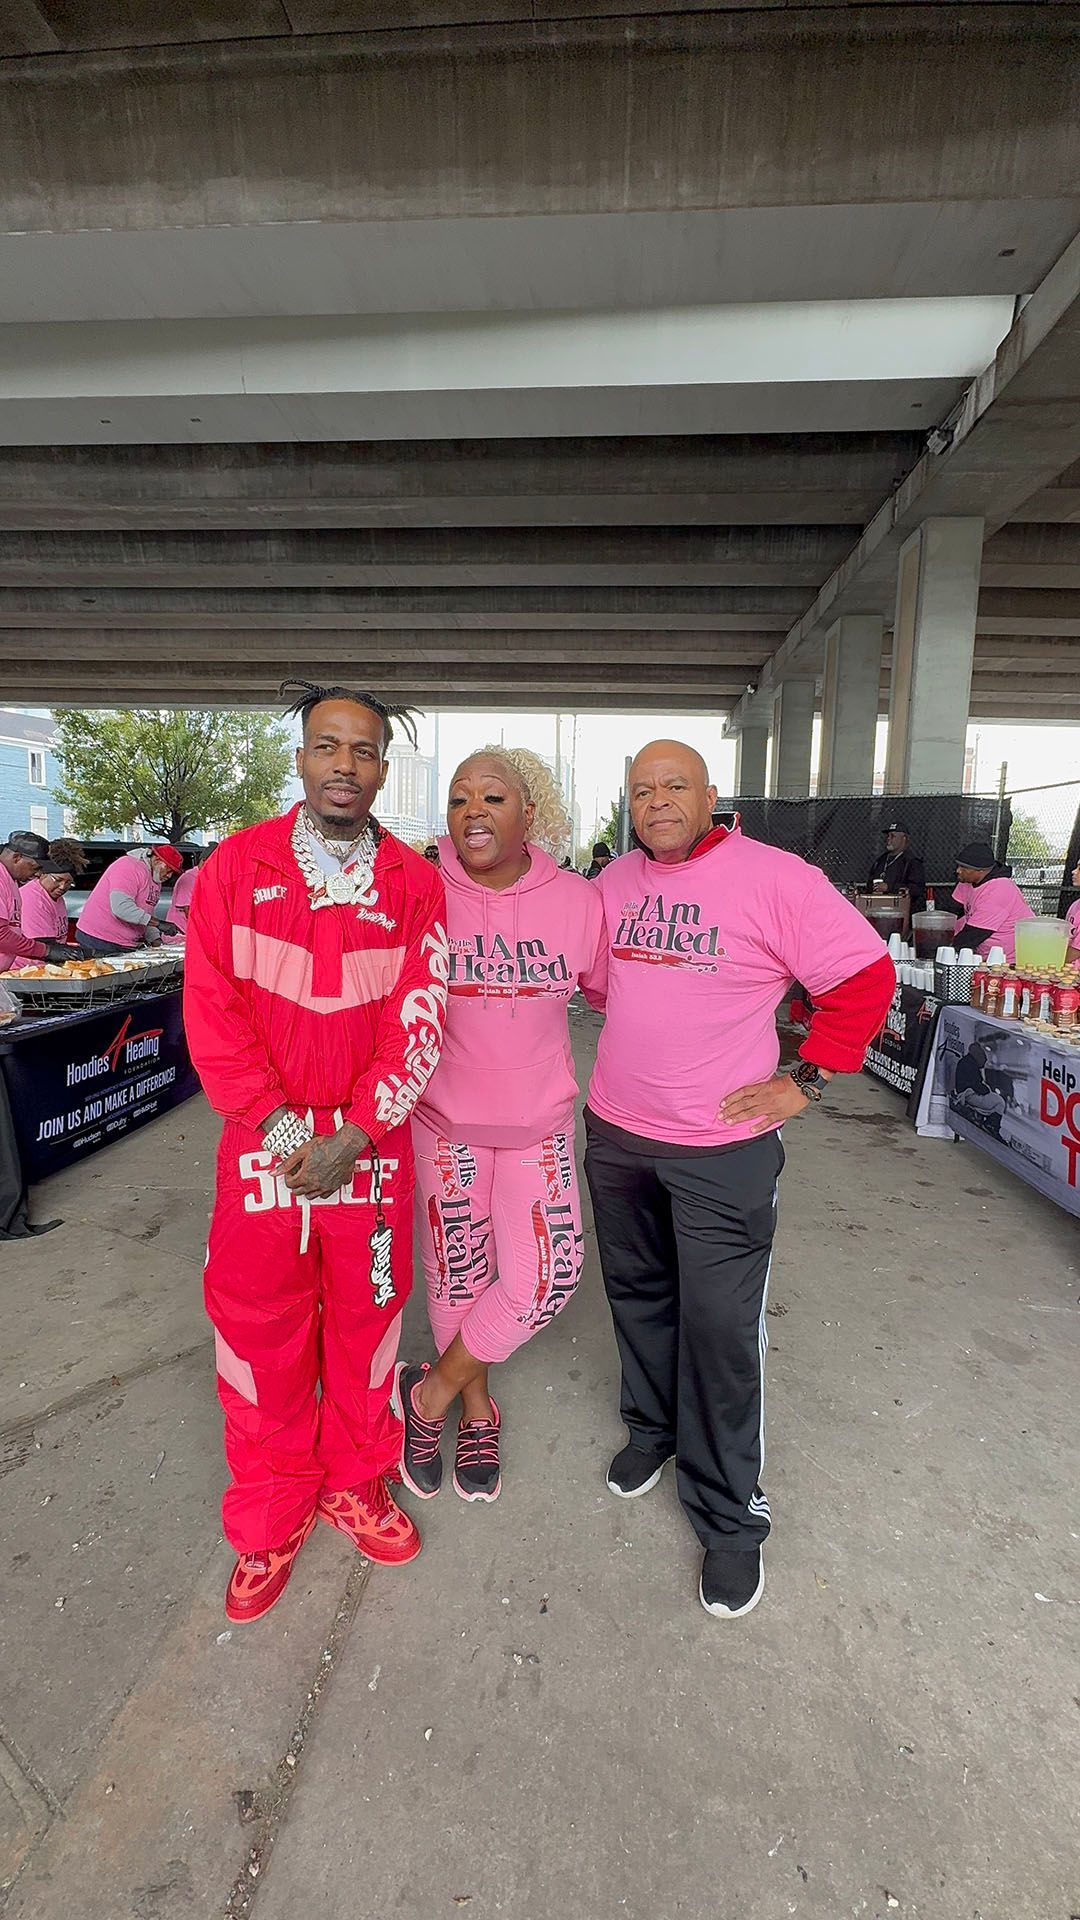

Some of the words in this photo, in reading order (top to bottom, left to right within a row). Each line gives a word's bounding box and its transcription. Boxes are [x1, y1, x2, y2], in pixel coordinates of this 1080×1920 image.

[637, 895, 650, 921] I
[645, 894, 701, 926] Am
[474, 934, 485, 958] I
[488, 934, 549, 961] Am
[613, 918, 725, 957] Healed.
[447, 953, 573, 984] Healed.
[66, 1055, 110, 1087] Hoodies
[126, 1035, 160, 1064] Healing
[1042, 1058, 1077, 1093] Help
[36, 1115, 64, 1142] JOIN
[67, 1109, 81, 1130] US
[83, 1100, 102, 1124] AND
[104, 1088, 128, 1114] MAKE
[129, 1085, 135, 1102] A
[136, 1066, 176, 1099] DIFFERENCE!
[239, 1151, 399, 1212] SCE
[440, 1198, 474, 1307] Healed.
[470, 1234, 490, 1284] Am
